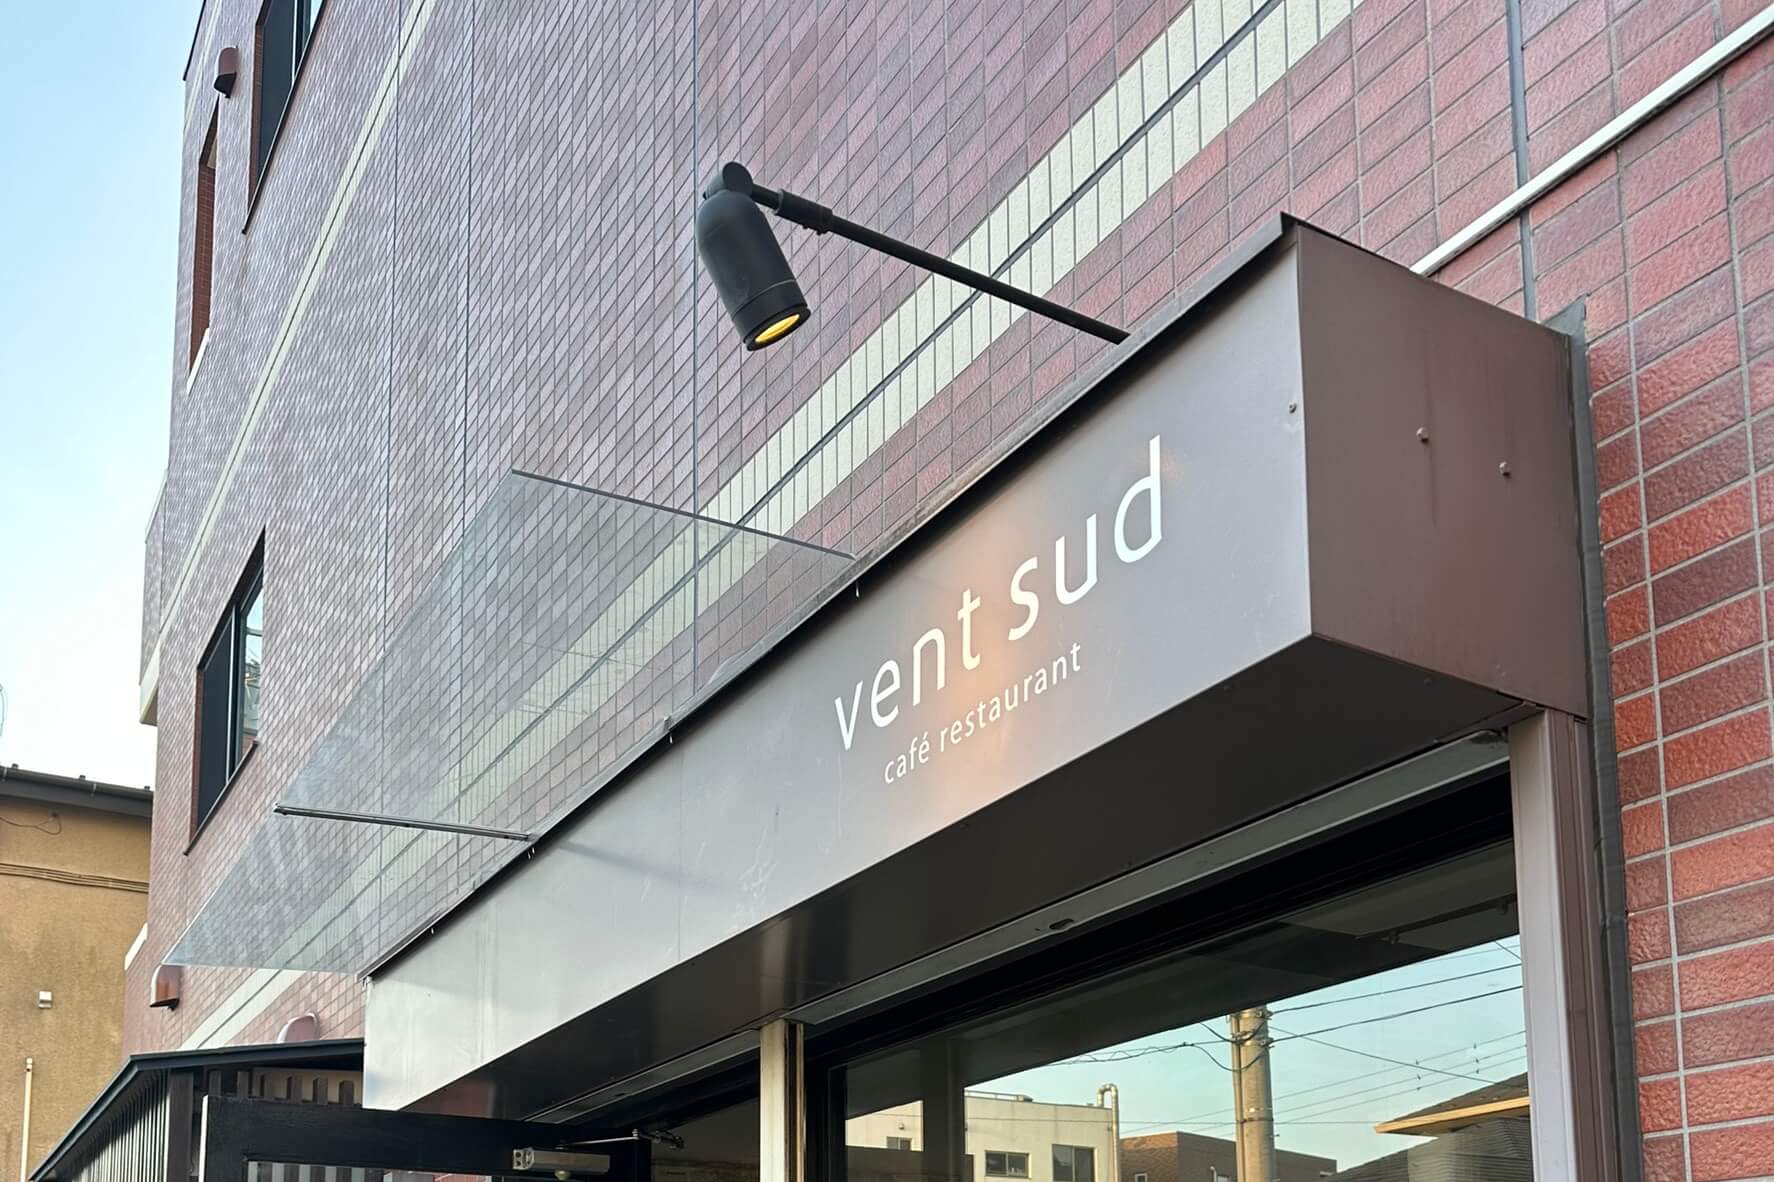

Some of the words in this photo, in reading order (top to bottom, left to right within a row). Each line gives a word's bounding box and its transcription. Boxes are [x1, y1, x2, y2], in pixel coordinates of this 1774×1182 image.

[834, 588, 981, 751] vent
[1008, 434, 1162, 641] sud
[884, 732, 929, 783] café
[940, 643, 1081, 752] restaurant
